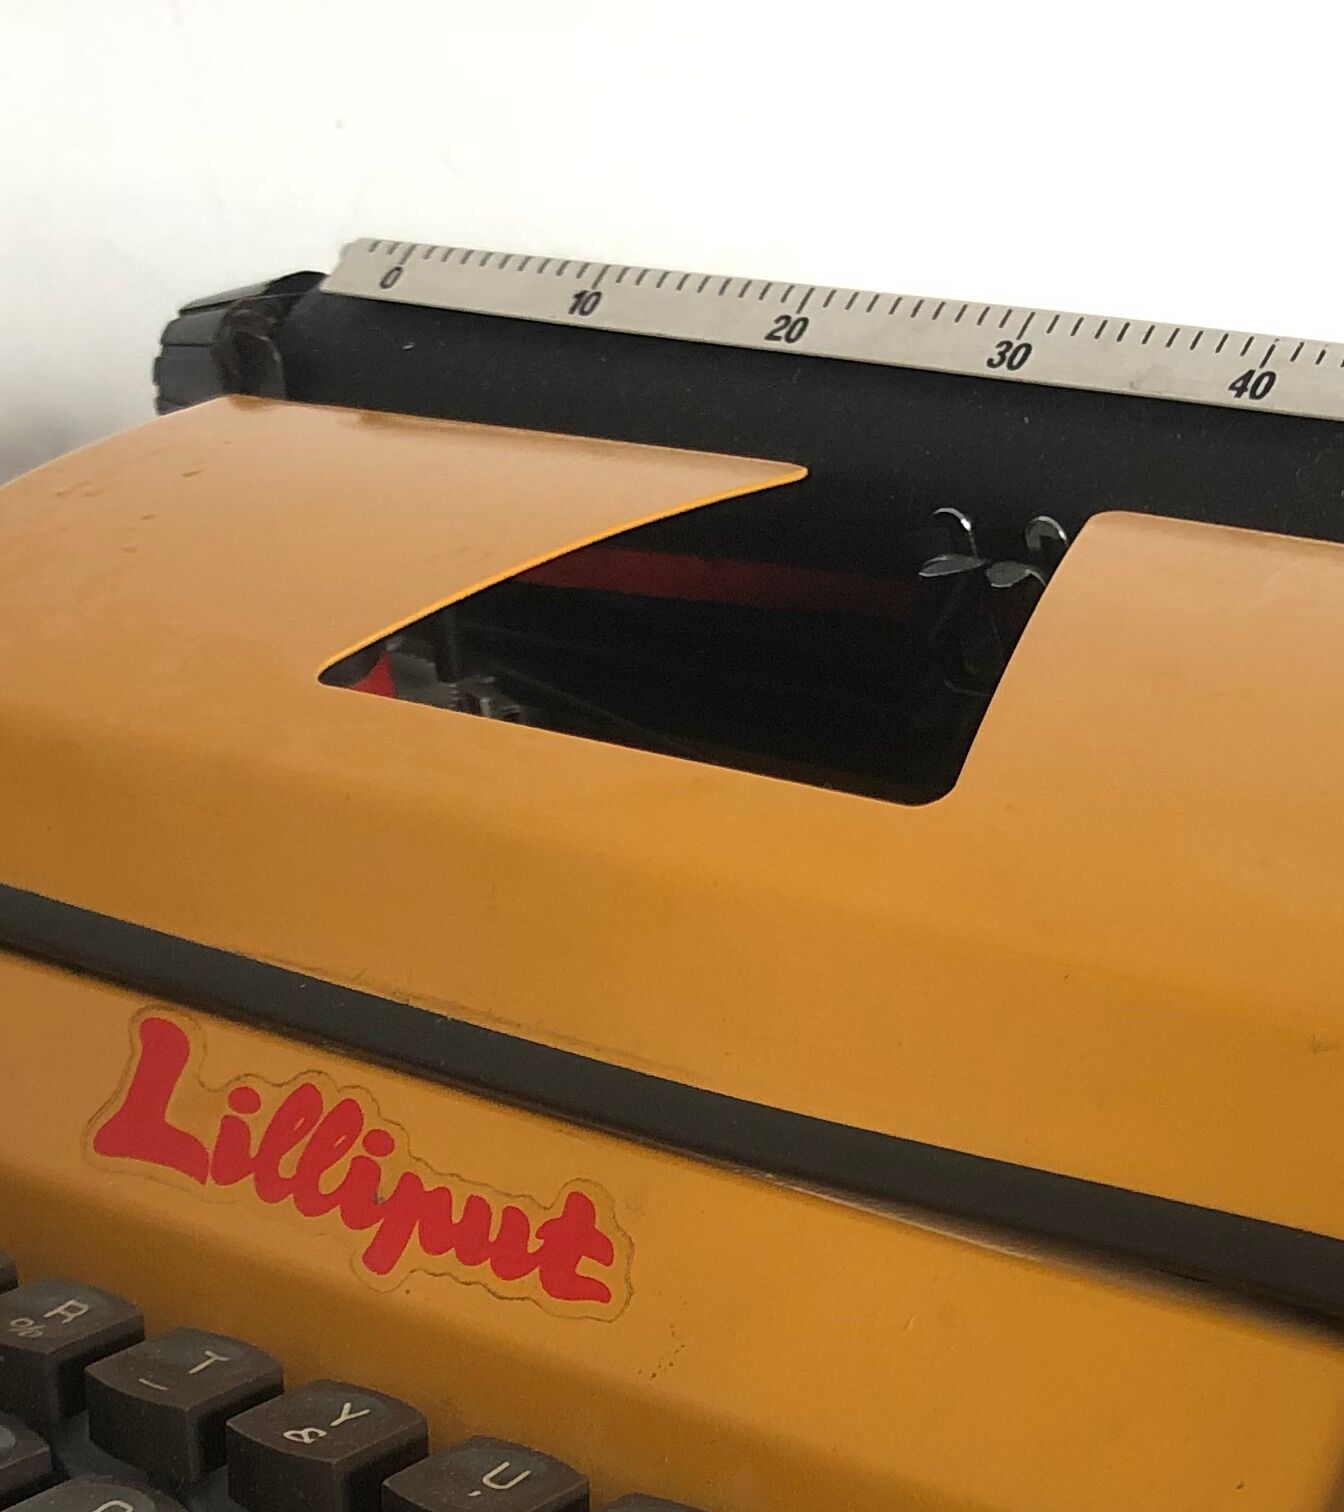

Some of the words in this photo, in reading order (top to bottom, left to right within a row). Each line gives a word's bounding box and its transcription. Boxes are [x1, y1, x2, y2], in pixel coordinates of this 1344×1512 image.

[379, 266, 404, 290] 0
[568, 290, 603, 318] 10
[765, 314, 809, 345] 20
[986, 341, 1032, 373] 30
[1227, 370, 1276, 401] 40
[93, 1016, 615, 1304] Lilliput
[43, 1299, 90, 1324] R
[188, 1350, 230, 1375] T
[329, 1402, 371, 1427] Y
[482, 1461, 531, 1490] U
